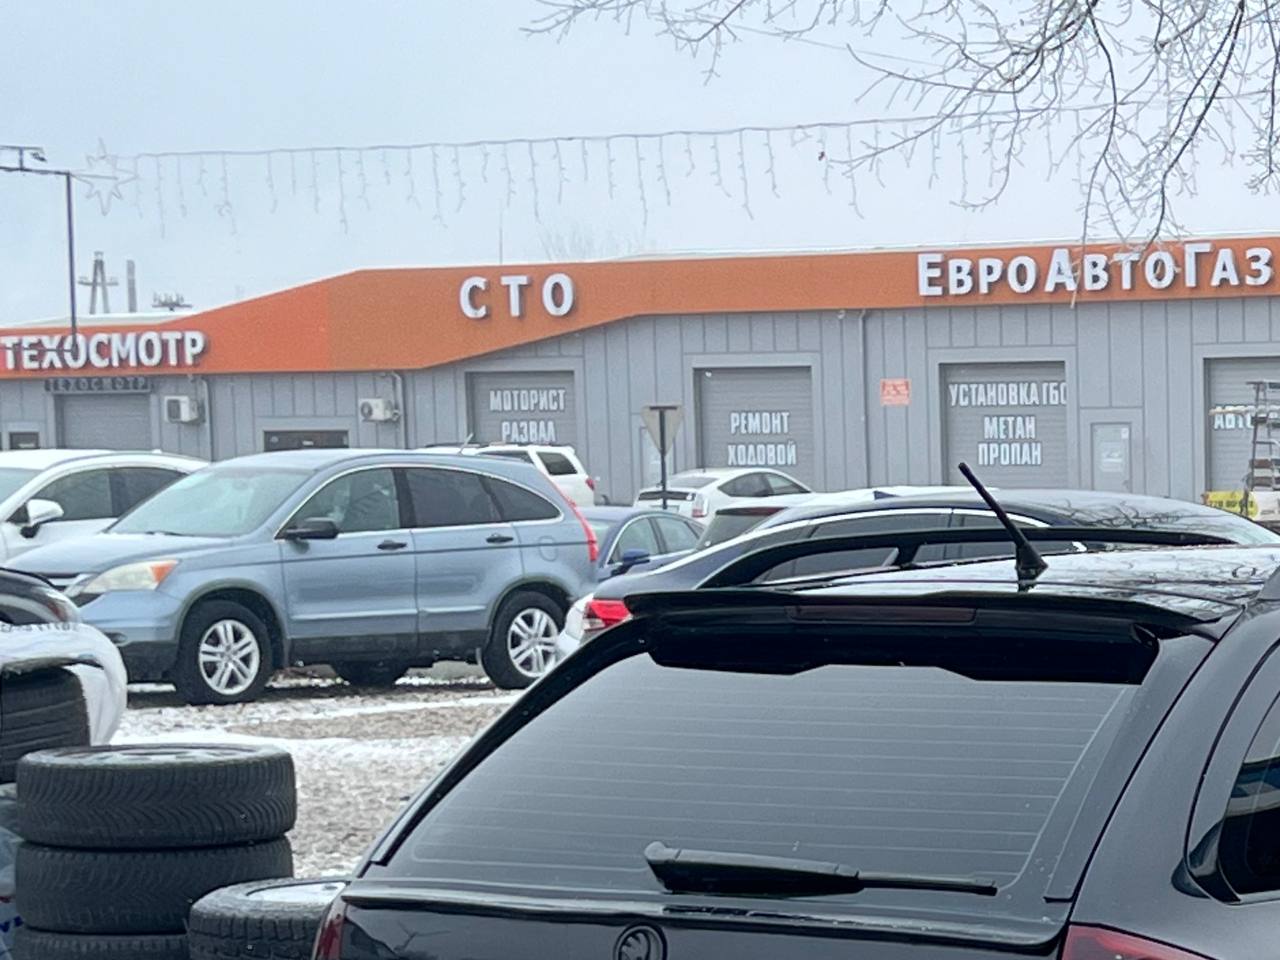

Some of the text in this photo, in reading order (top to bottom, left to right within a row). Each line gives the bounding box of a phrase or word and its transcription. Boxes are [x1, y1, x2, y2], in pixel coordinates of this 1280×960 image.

[459, 273, 574, 318] СТО
[2, 331, 205, 369] ТЕХОСМОТР
[489, 389, 566, 411] МОТОРИСТ
[949, 382, 1039, 406] УСТАНОВКА
[501, 420, 556, 443] РАЗВАЛ
[730, 411, 790, 434] РЕМОНТ
[984, 416, 1036, 439] МЕТАН
[727, 440, 797, 466] ХОДОВОЙ
[978, 442, 1042, 466] ПРОПАН
